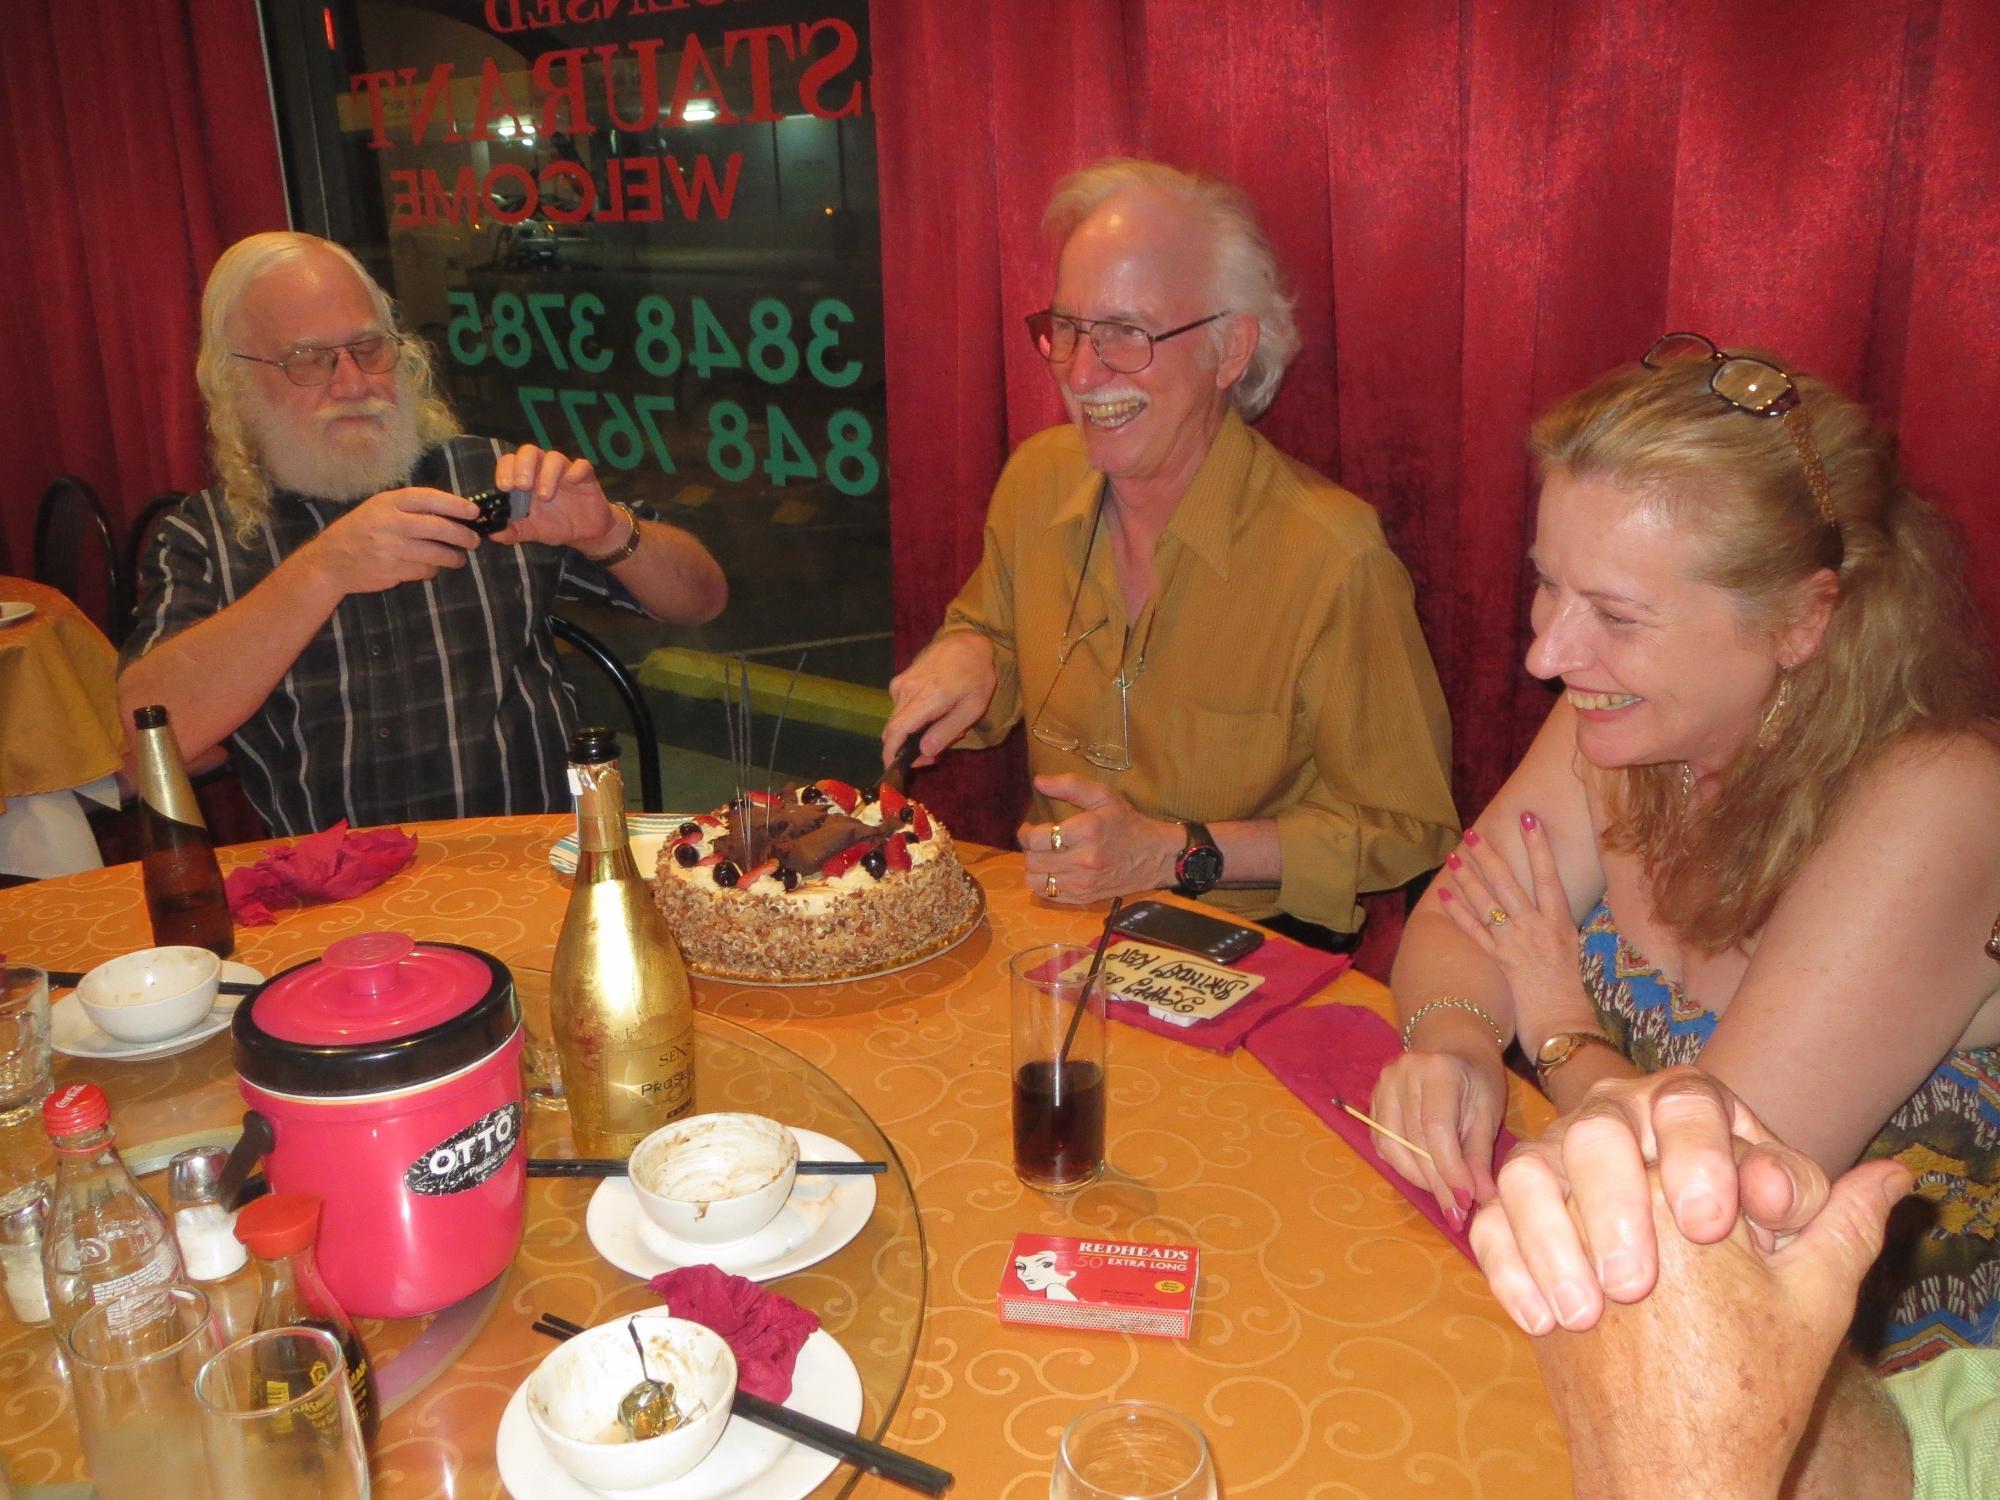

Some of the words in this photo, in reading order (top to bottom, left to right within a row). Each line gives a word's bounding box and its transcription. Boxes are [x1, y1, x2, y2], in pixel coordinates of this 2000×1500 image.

[428, 1114, 512, 1175] OTTO
[1078, 1242, 1189, 1261] REDHEADS
[1073, 1255, 1104, 1269] 50
[1107, 1258, 1146, 1268] EXTRA
[1150, 1262, 1187, 1271] LONG
